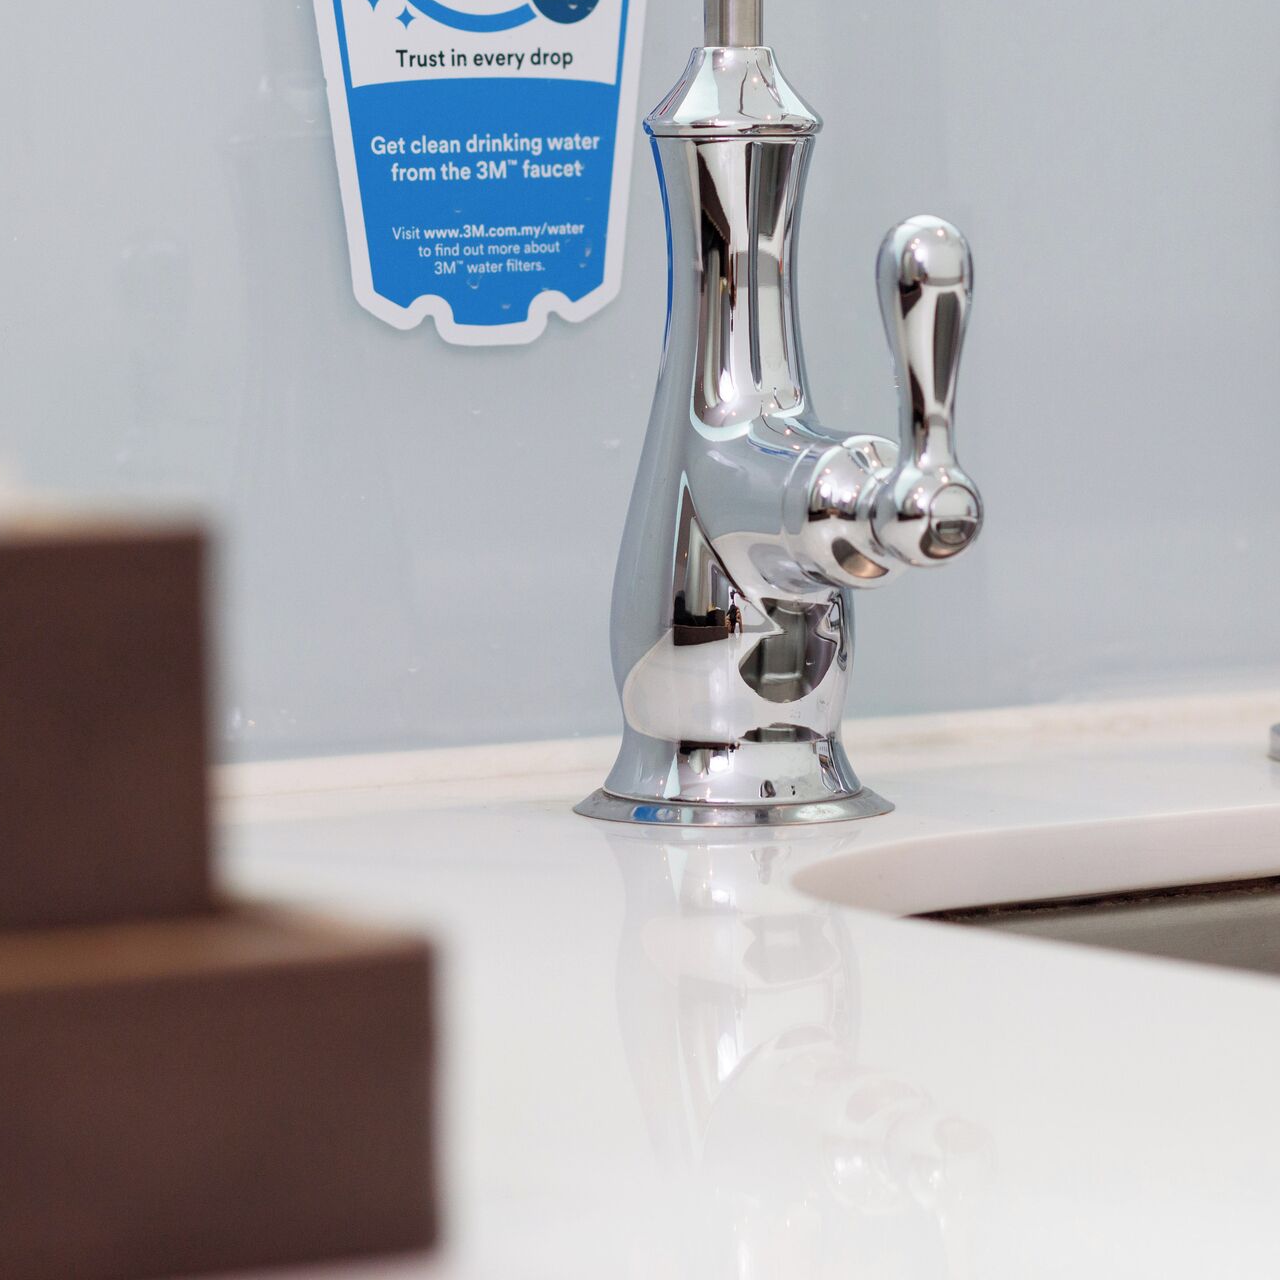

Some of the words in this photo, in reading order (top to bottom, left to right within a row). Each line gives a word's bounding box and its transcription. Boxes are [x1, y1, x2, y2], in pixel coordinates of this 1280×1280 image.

[396, 49, 445, 68] Trust
[451, 48, 467, 67] in
[472, 51, 525, 70] every
[530, 47, 574, 69] drop
[370, 136, 405, 155] Get
[411, 135, 461, 154] clean
[466, 133, 542, 155] drinking
[547, 133, 600, 151] water
[391, 163, 436, 182] from
[440, 162, 471, 180] the
[523, 160, 582, 178] faucet
[392, 227, 420, 240] Visit
[424, 222, 585, 241] www.3M.com.my/water
[418, 245, 431, 257] to
[435, 243, 460, 256] find
[463, 243, 484, 256] out
[488, 244, 520, 255] more
[524, 241, 560, 254] about
[467, 261, 504, 273] water
[506, 258, 546, 272] filters.
